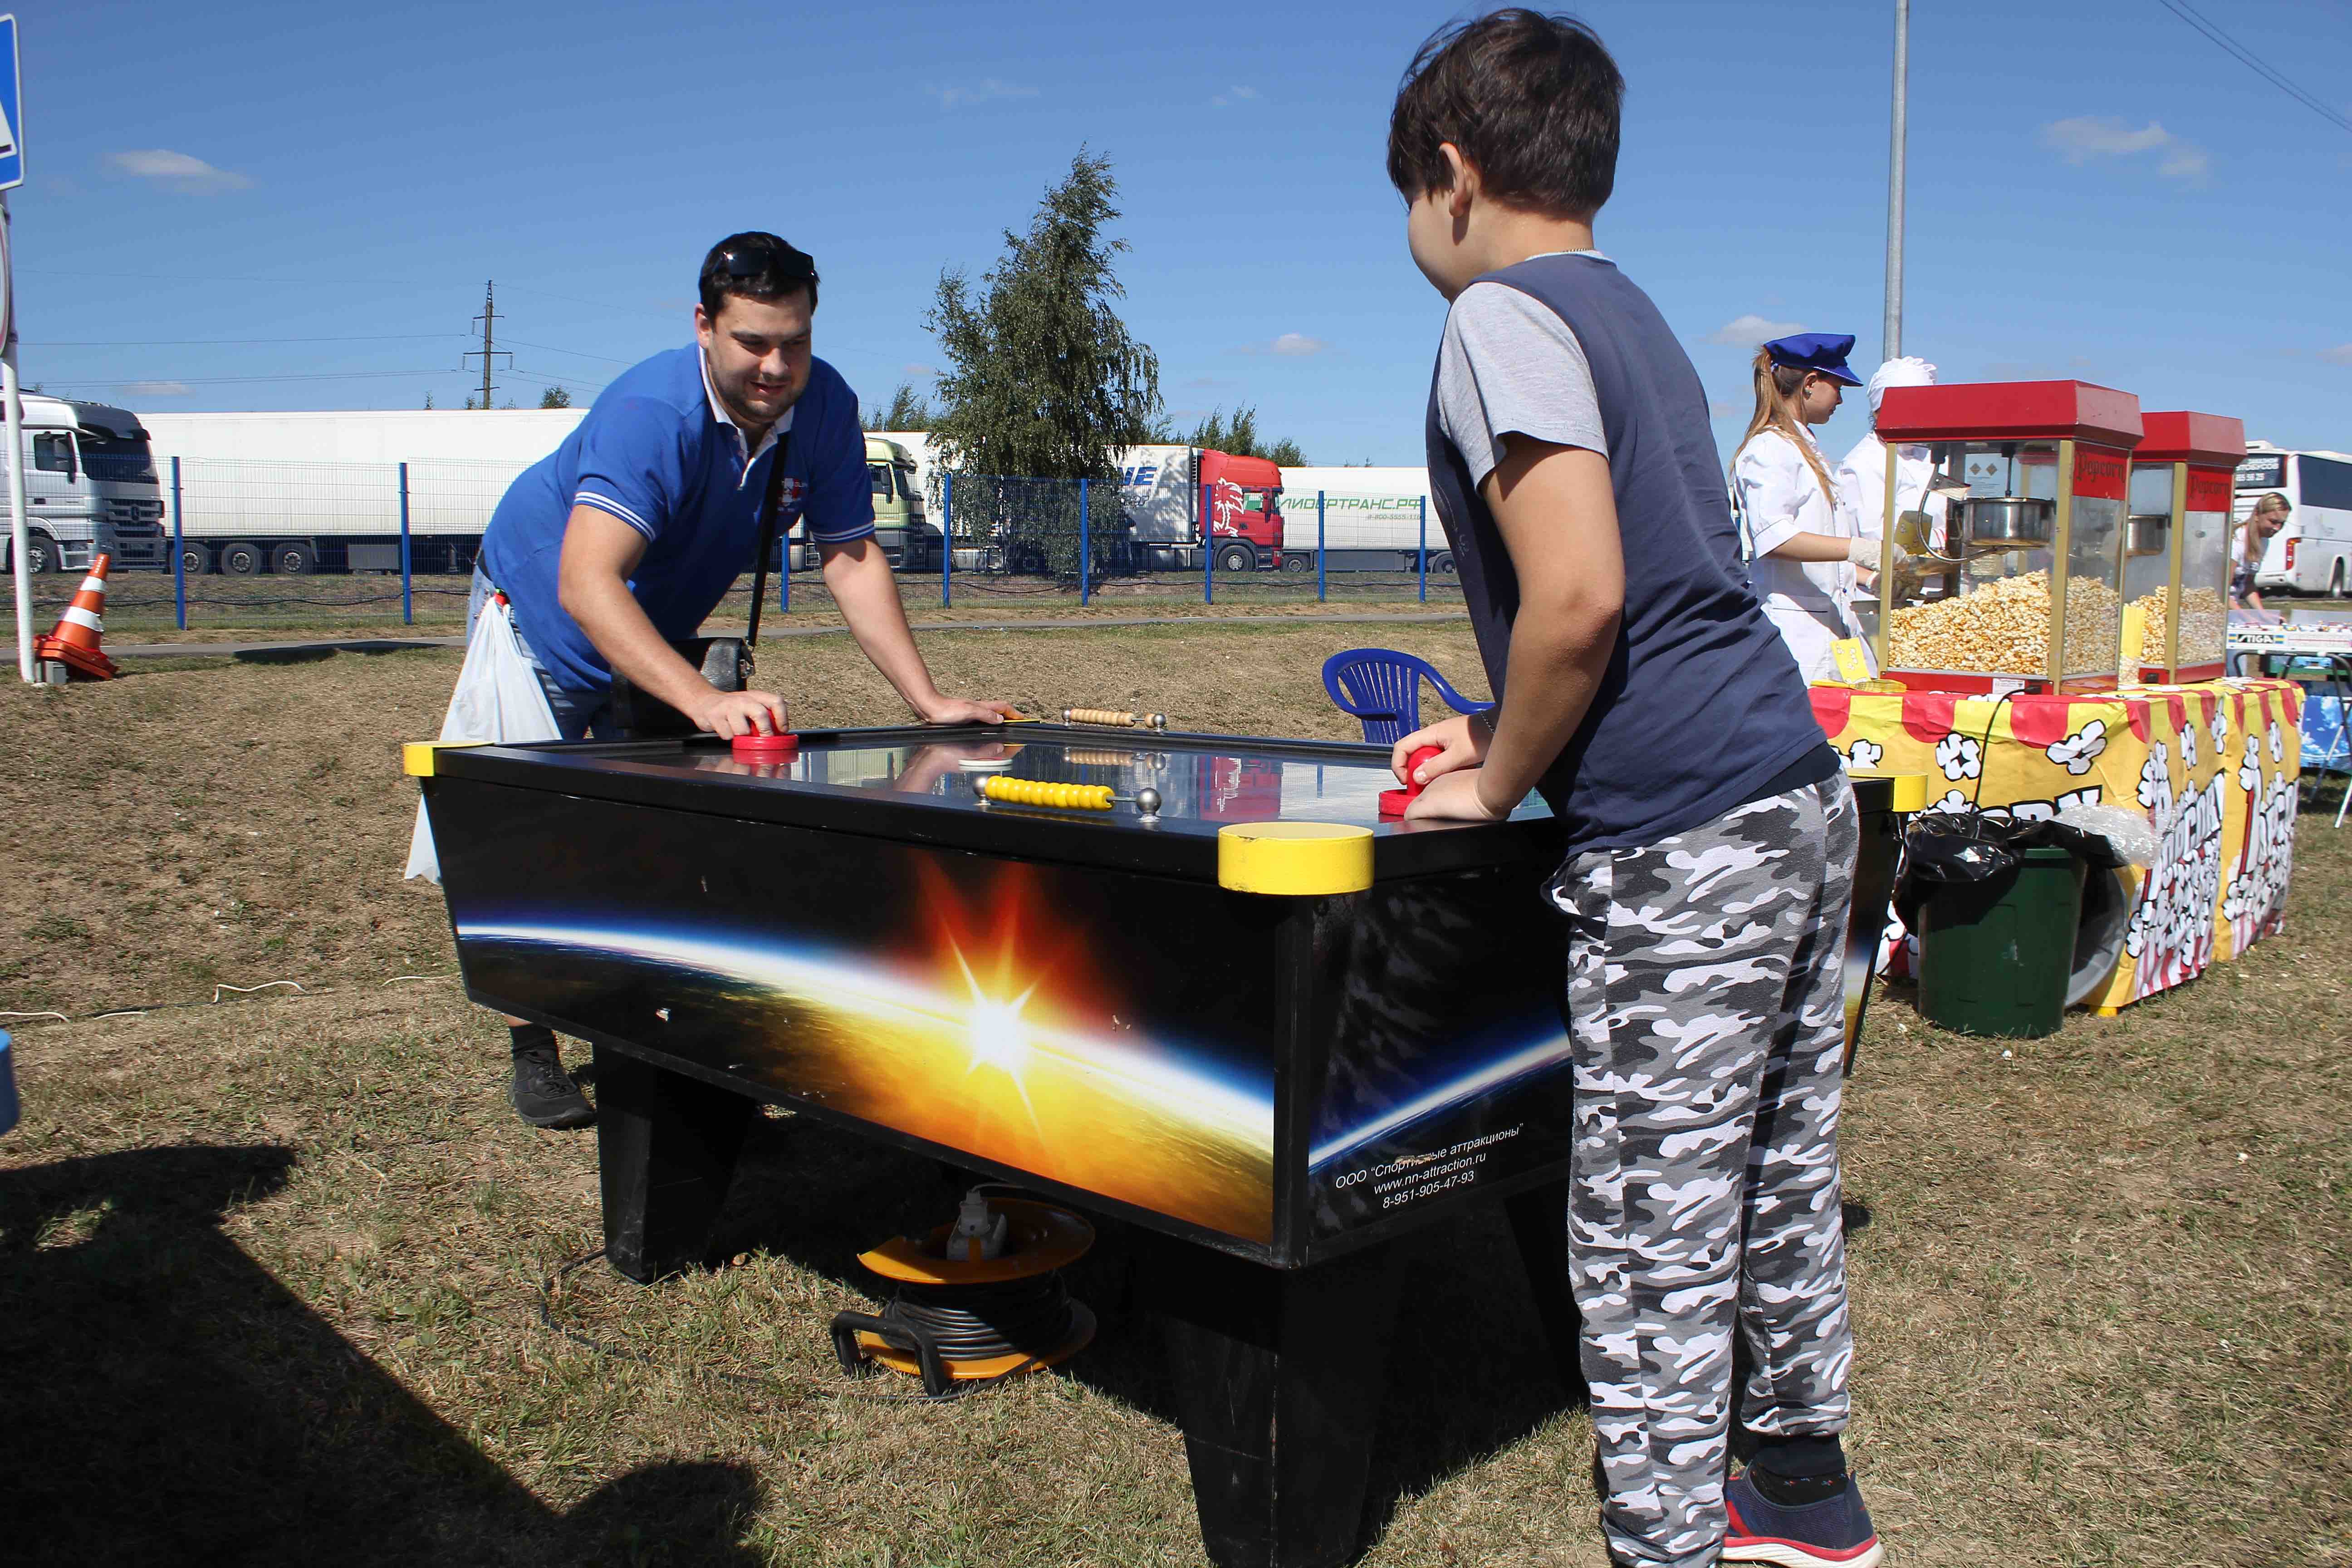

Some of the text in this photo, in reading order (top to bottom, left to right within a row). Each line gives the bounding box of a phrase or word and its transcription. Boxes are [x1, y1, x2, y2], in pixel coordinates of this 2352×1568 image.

[2075, 451, 2126, 483] Popcorn
[2187, 476, 2230, 500] Popcorn
[2238, 635, 2273, 643] STIGA
[1336, 1170, 1367, 1188] ООО
[1374, 1153, 1486, 1194] www.nn-attraction.ru
[1383, 1170, 1474, 1208] 8-951-905-47-93
